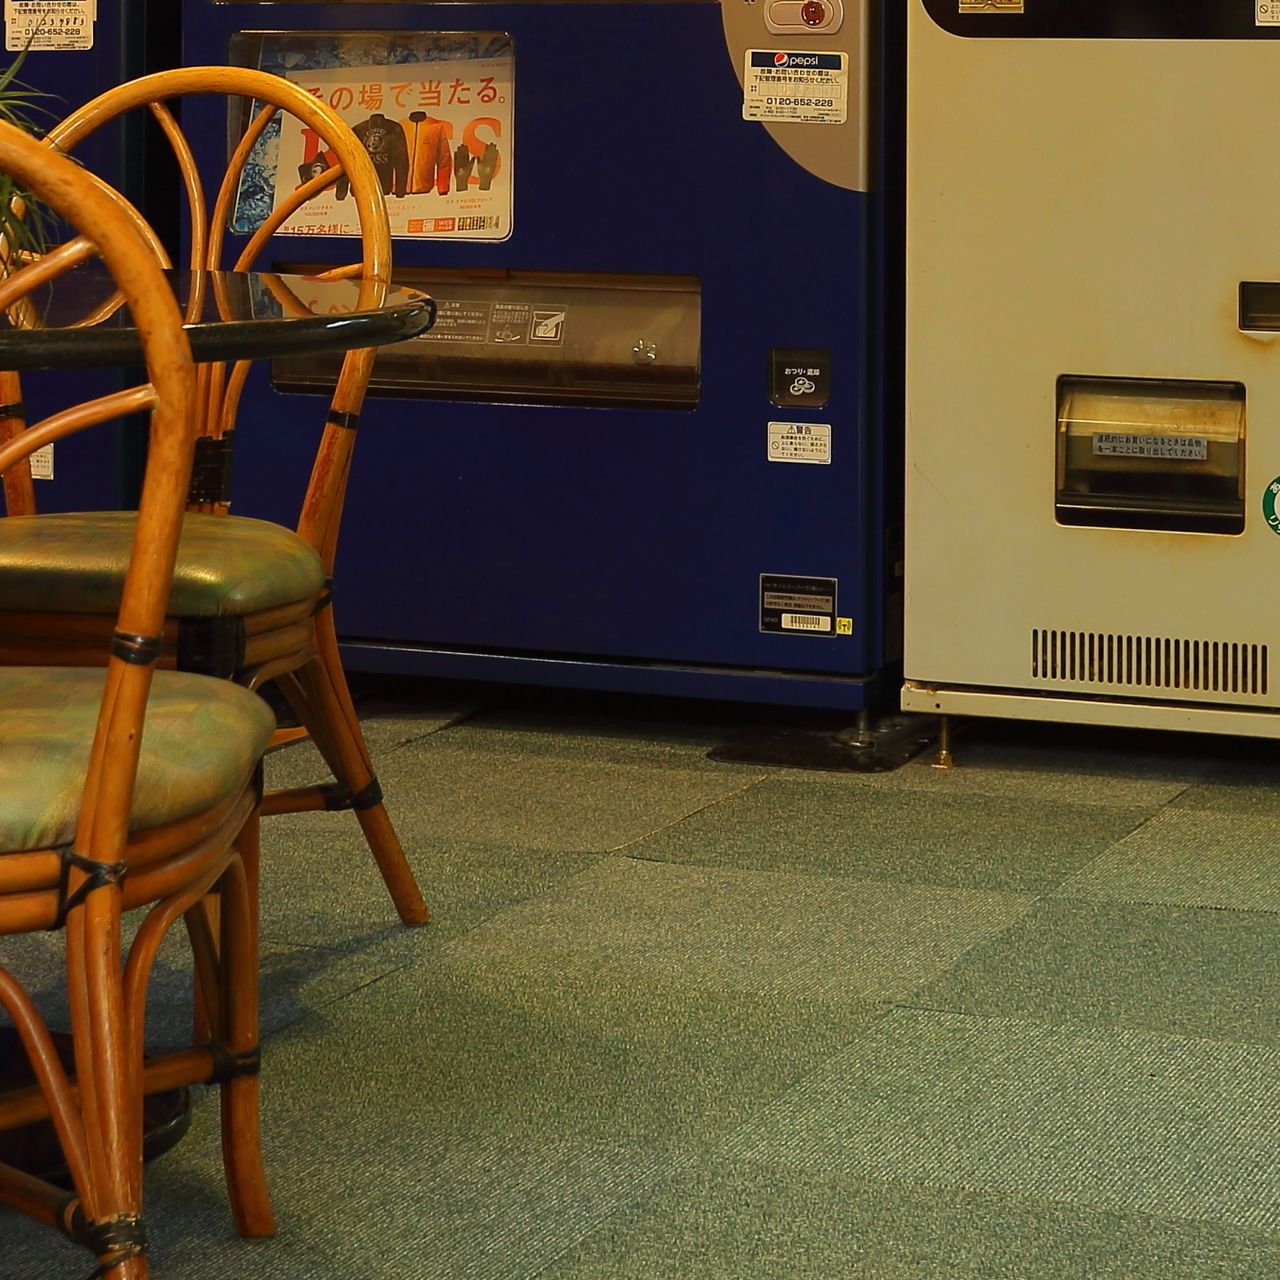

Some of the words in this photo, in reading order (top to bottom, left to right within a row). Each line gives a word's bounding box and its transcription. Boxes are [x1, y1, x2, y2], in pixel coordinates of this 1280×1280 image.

[789, 56, 819, 66] pepsi
[766, 98, 833, 107] 0120-652-228
[784, 368, 820, 376] おつり・返却
[1097, 445, 1206, 460] を一本ごとに取り出してください。
